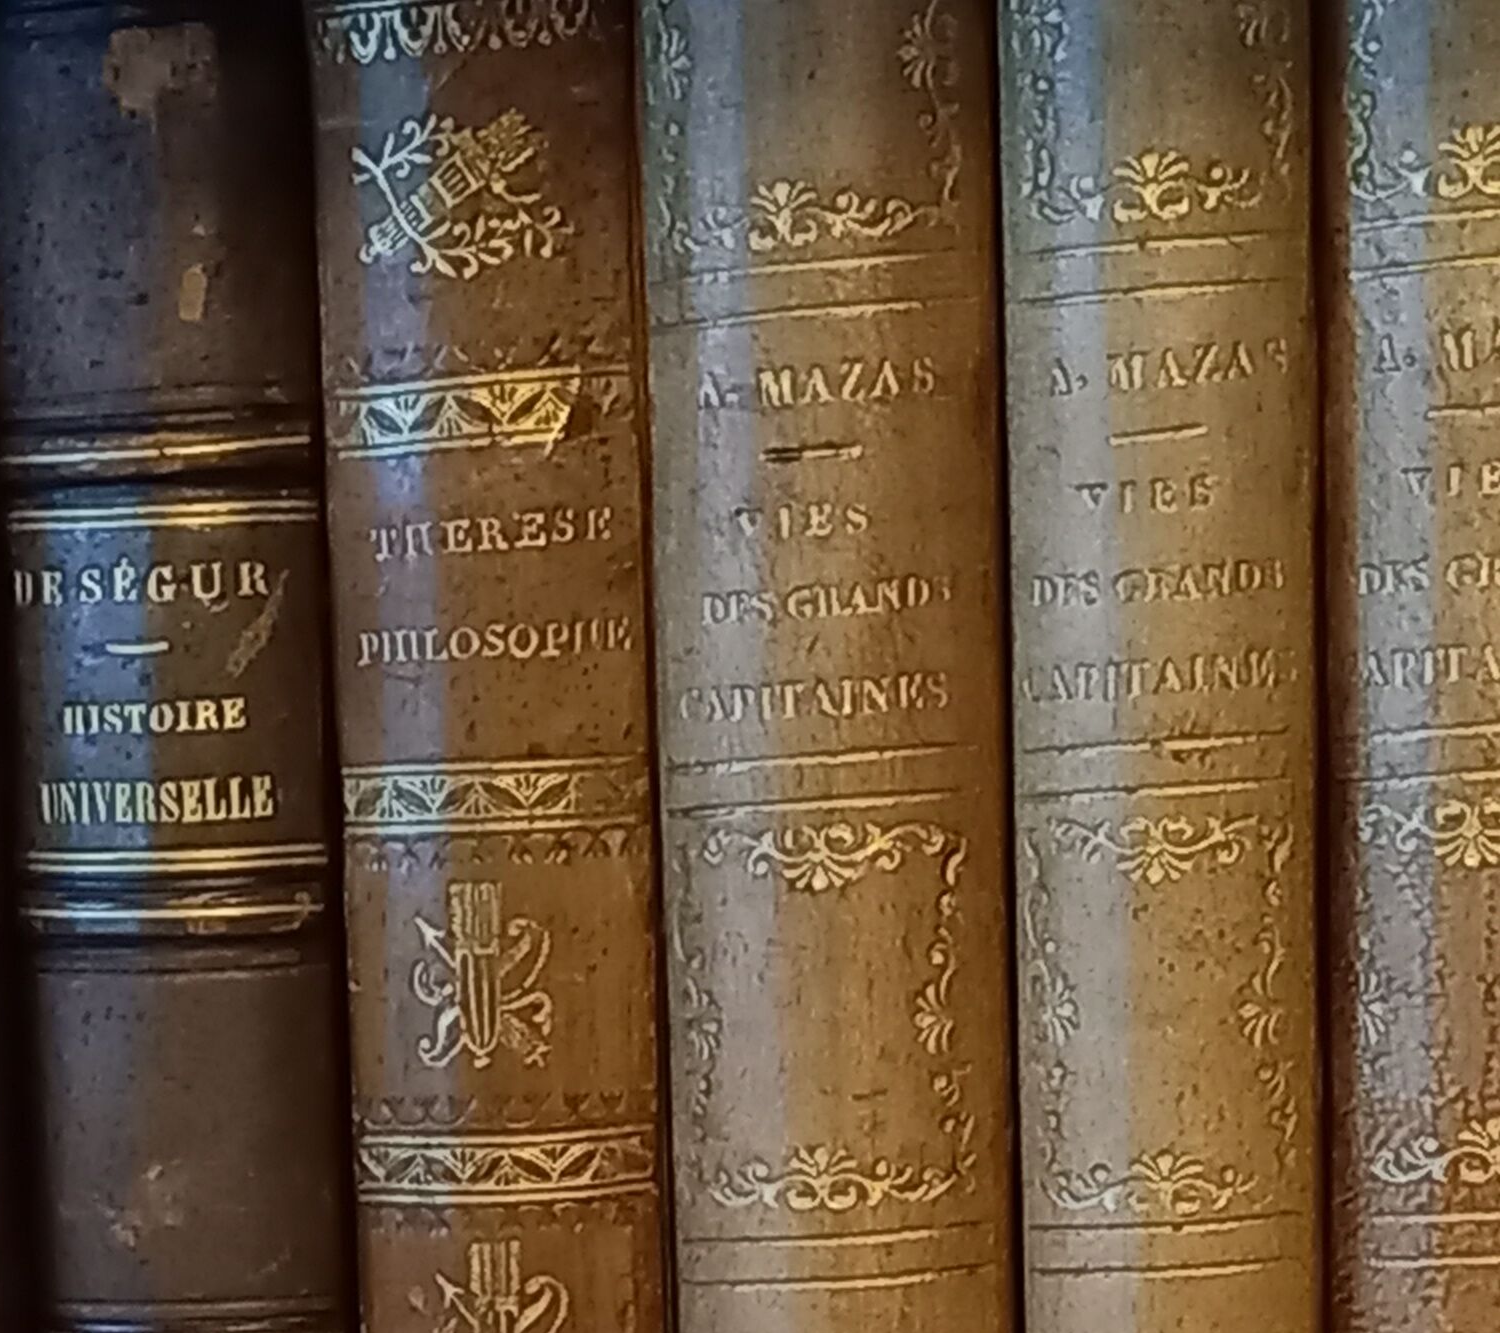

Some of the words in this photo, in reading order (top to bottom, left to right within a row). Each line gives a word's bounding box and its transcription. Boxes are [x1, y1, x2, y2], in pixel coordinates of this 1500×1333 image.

[759, 357, 935, 407] MAZAS
[1107, 338, 1287, 391] MAZAS
[735, 503, 869, 539] VIES
[14, 570, 64, 608] DE
[80, 557, 269, 604] SÉGUR
[702, 590, 777, 625] DES
[787, 574, 951, 619] GRANDS
[1033, 569, 1100, 606] DES
[1113, 559, 1286, 602] GRANDS
[1358, 555, 1431, 595] DES
[63, 698, 248, 736] HISTOIRE
[680, 672, 949, 722] CAPITAINES
[40, 775, 275, 826] UNIVERSELLE
